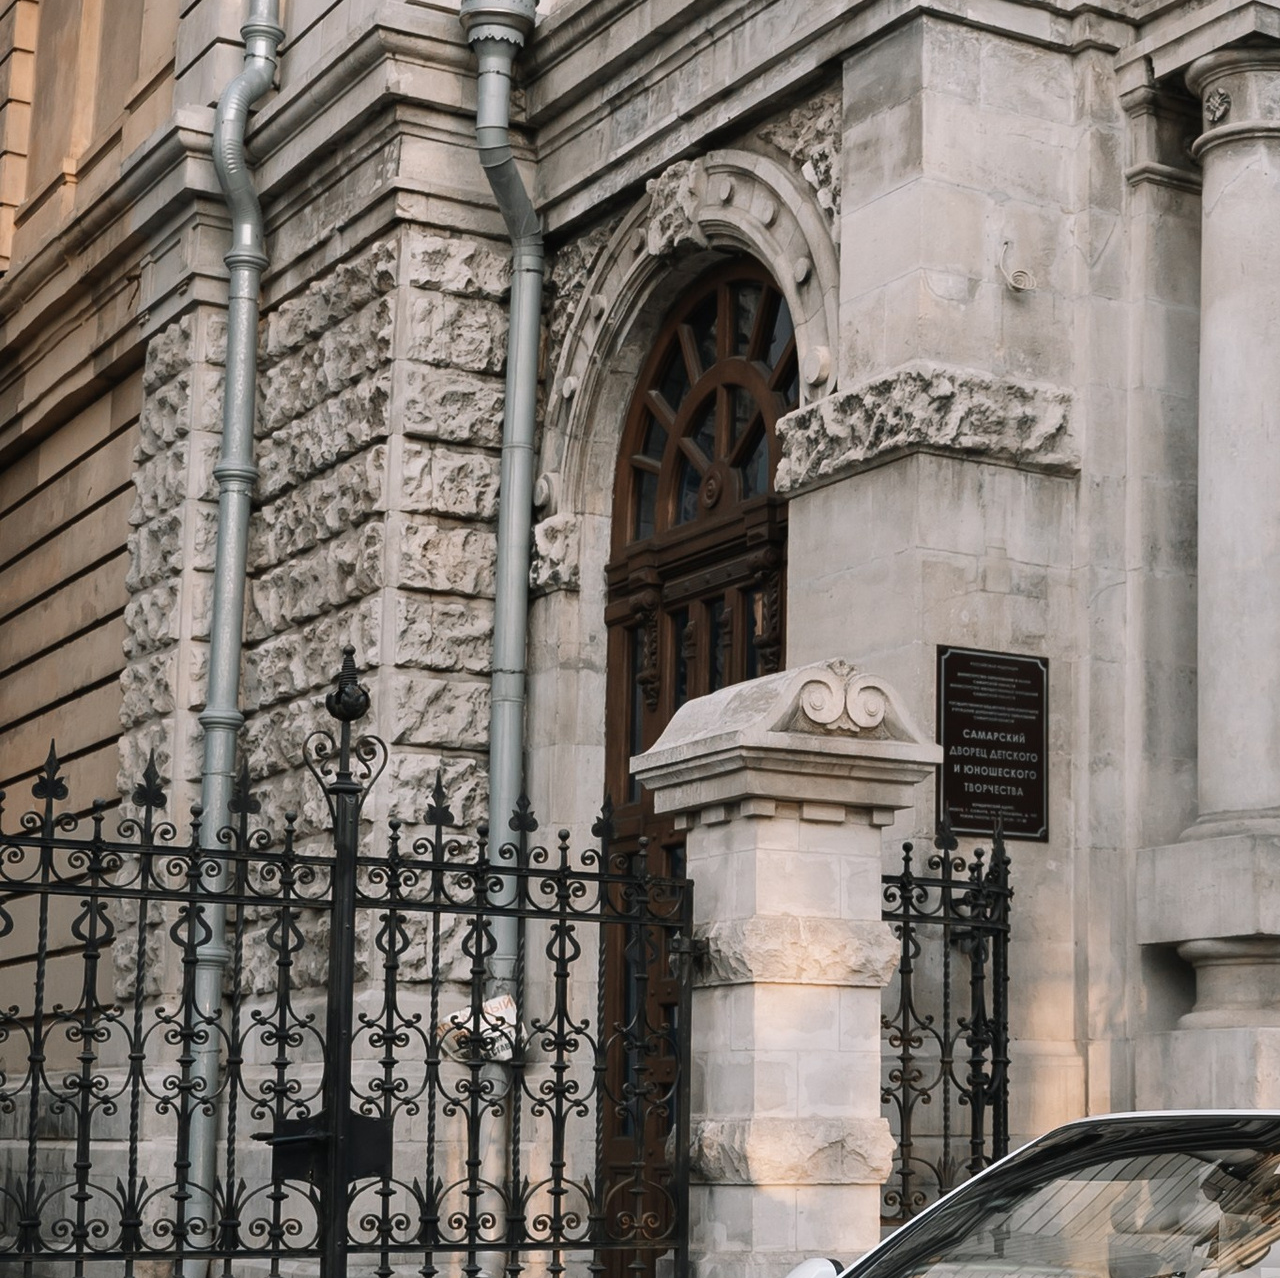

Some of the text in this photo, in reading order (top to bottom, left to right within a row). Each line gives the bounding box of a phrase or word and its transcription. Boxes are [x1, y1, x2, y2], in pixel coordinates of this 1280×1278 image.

[963, 729, 1025, 743] САМАРСКИЙ
[949, 746, 1038, 762] ДВОРЕЦ ДЕТСКОГО
[954, 764, 1036, 779] И ЮНОШЕСКОГО
[964, 783, 1023, 796] ТВОРЧЕСТВА
